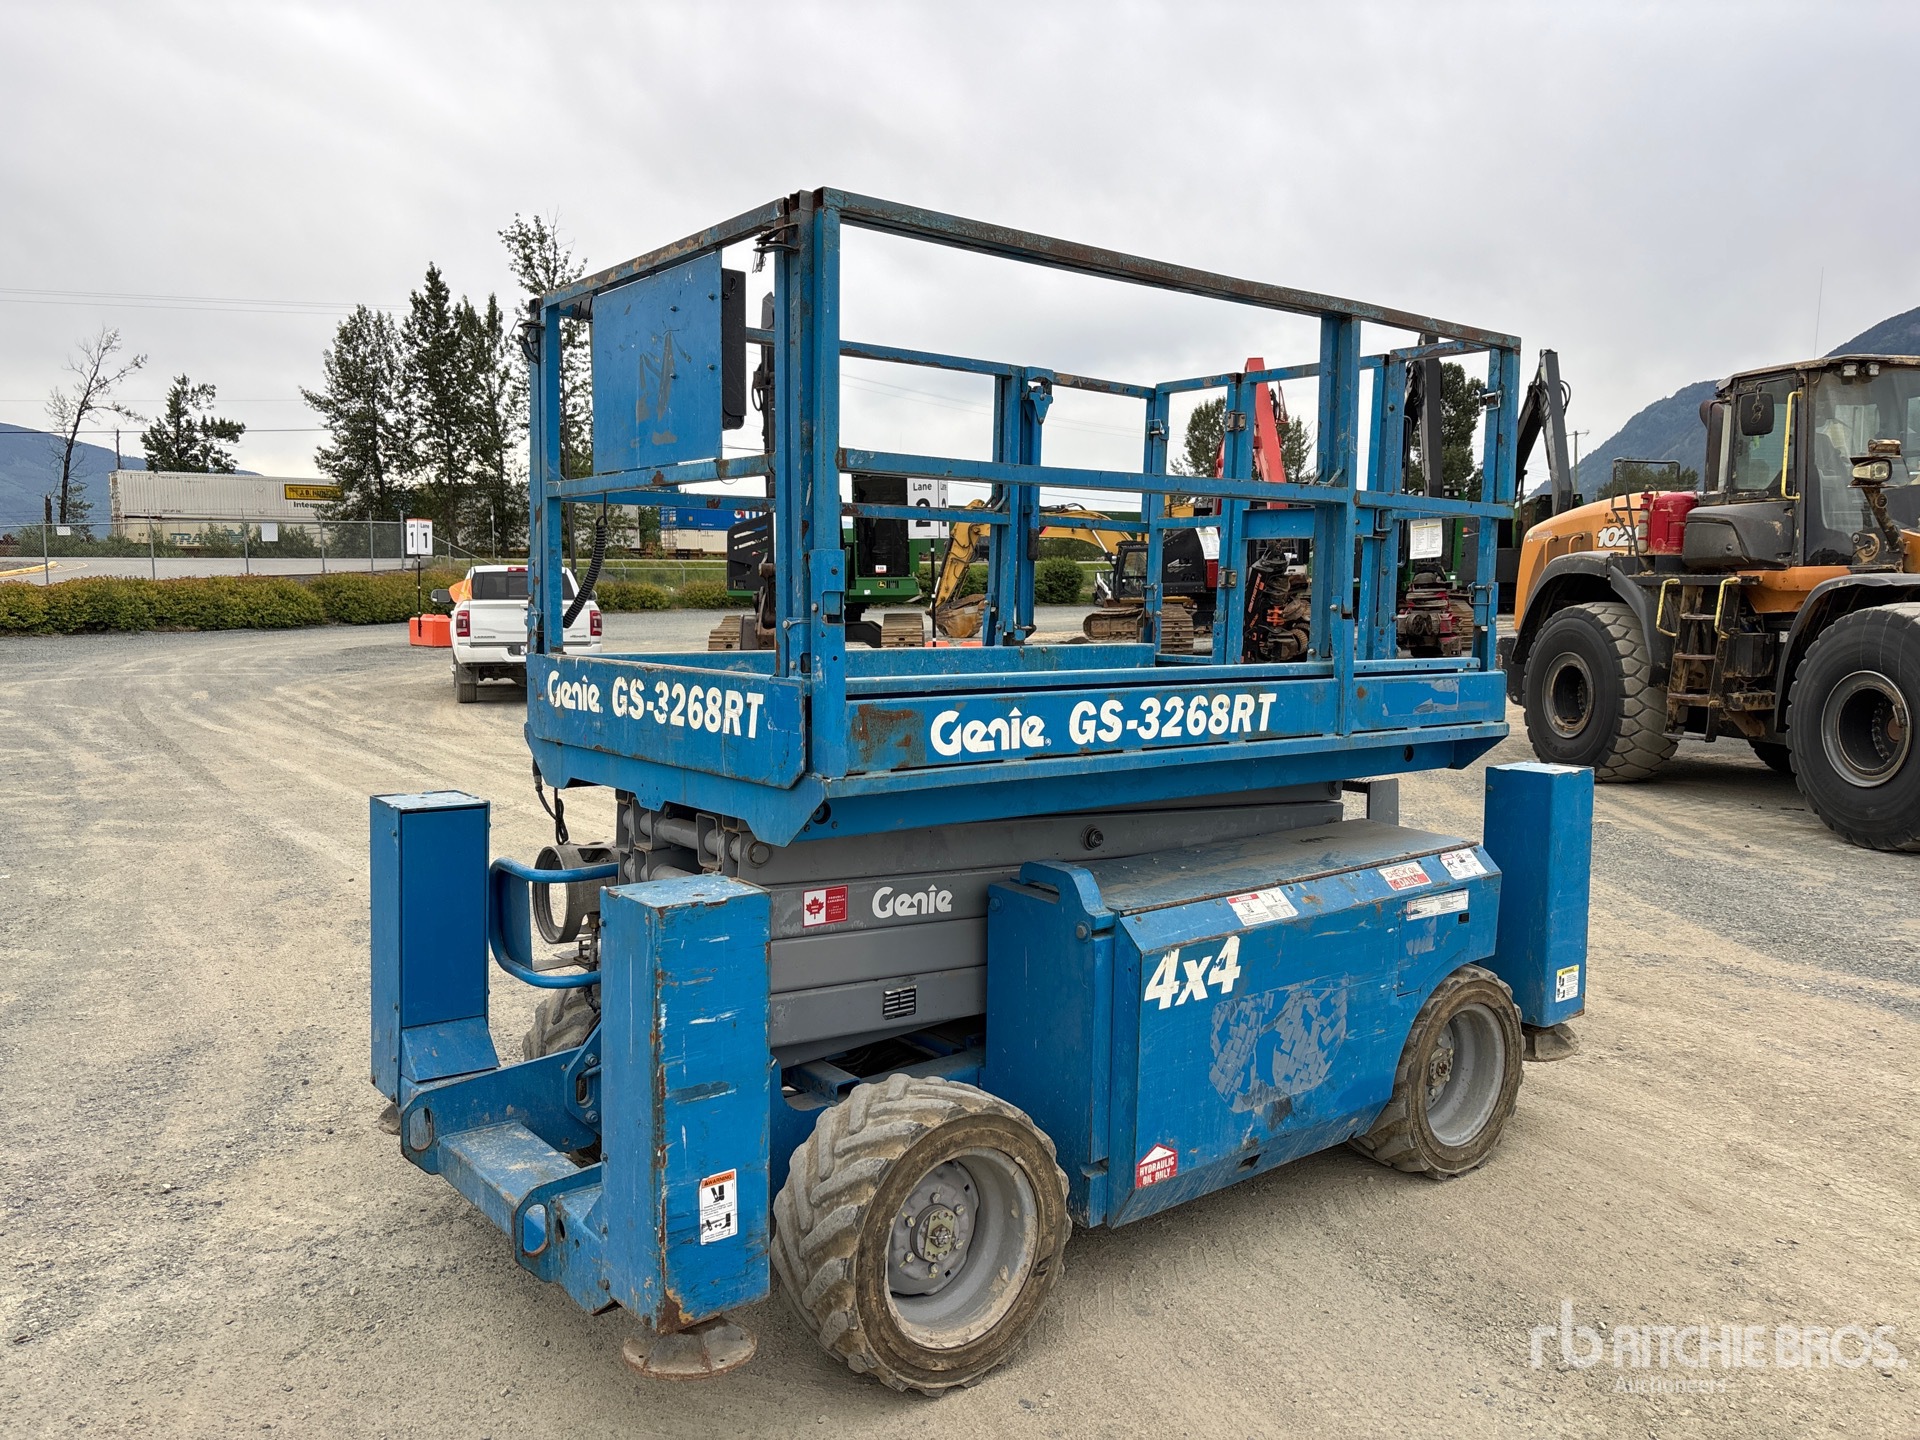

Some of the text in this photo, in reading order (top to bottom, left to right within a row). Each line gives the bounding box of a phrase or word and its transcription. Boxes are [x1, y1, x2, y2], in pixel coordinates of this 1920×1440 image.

[913, 483, 932, 491] Lane
[410, 532, 414, 548] 1
[423, 532, 428, 549] 1
[547, 670, 764, 739] Genie GS-3268RT
[930, 693, 1277, 757] Genie GS-3268RT
[1398, 875, 1420, 887] DAILY
[872, 884, 953, 919] Genie
[1144, 935, 1241, 1011] 4x4
[1140, 1156, 1175, 1177] HYDRAULIC
[1155, 1168, 1171, 1181] ONLY
[708, 1174, 732, 1184] WARNING
[1142, 1174, 1153, 1186] OIL
